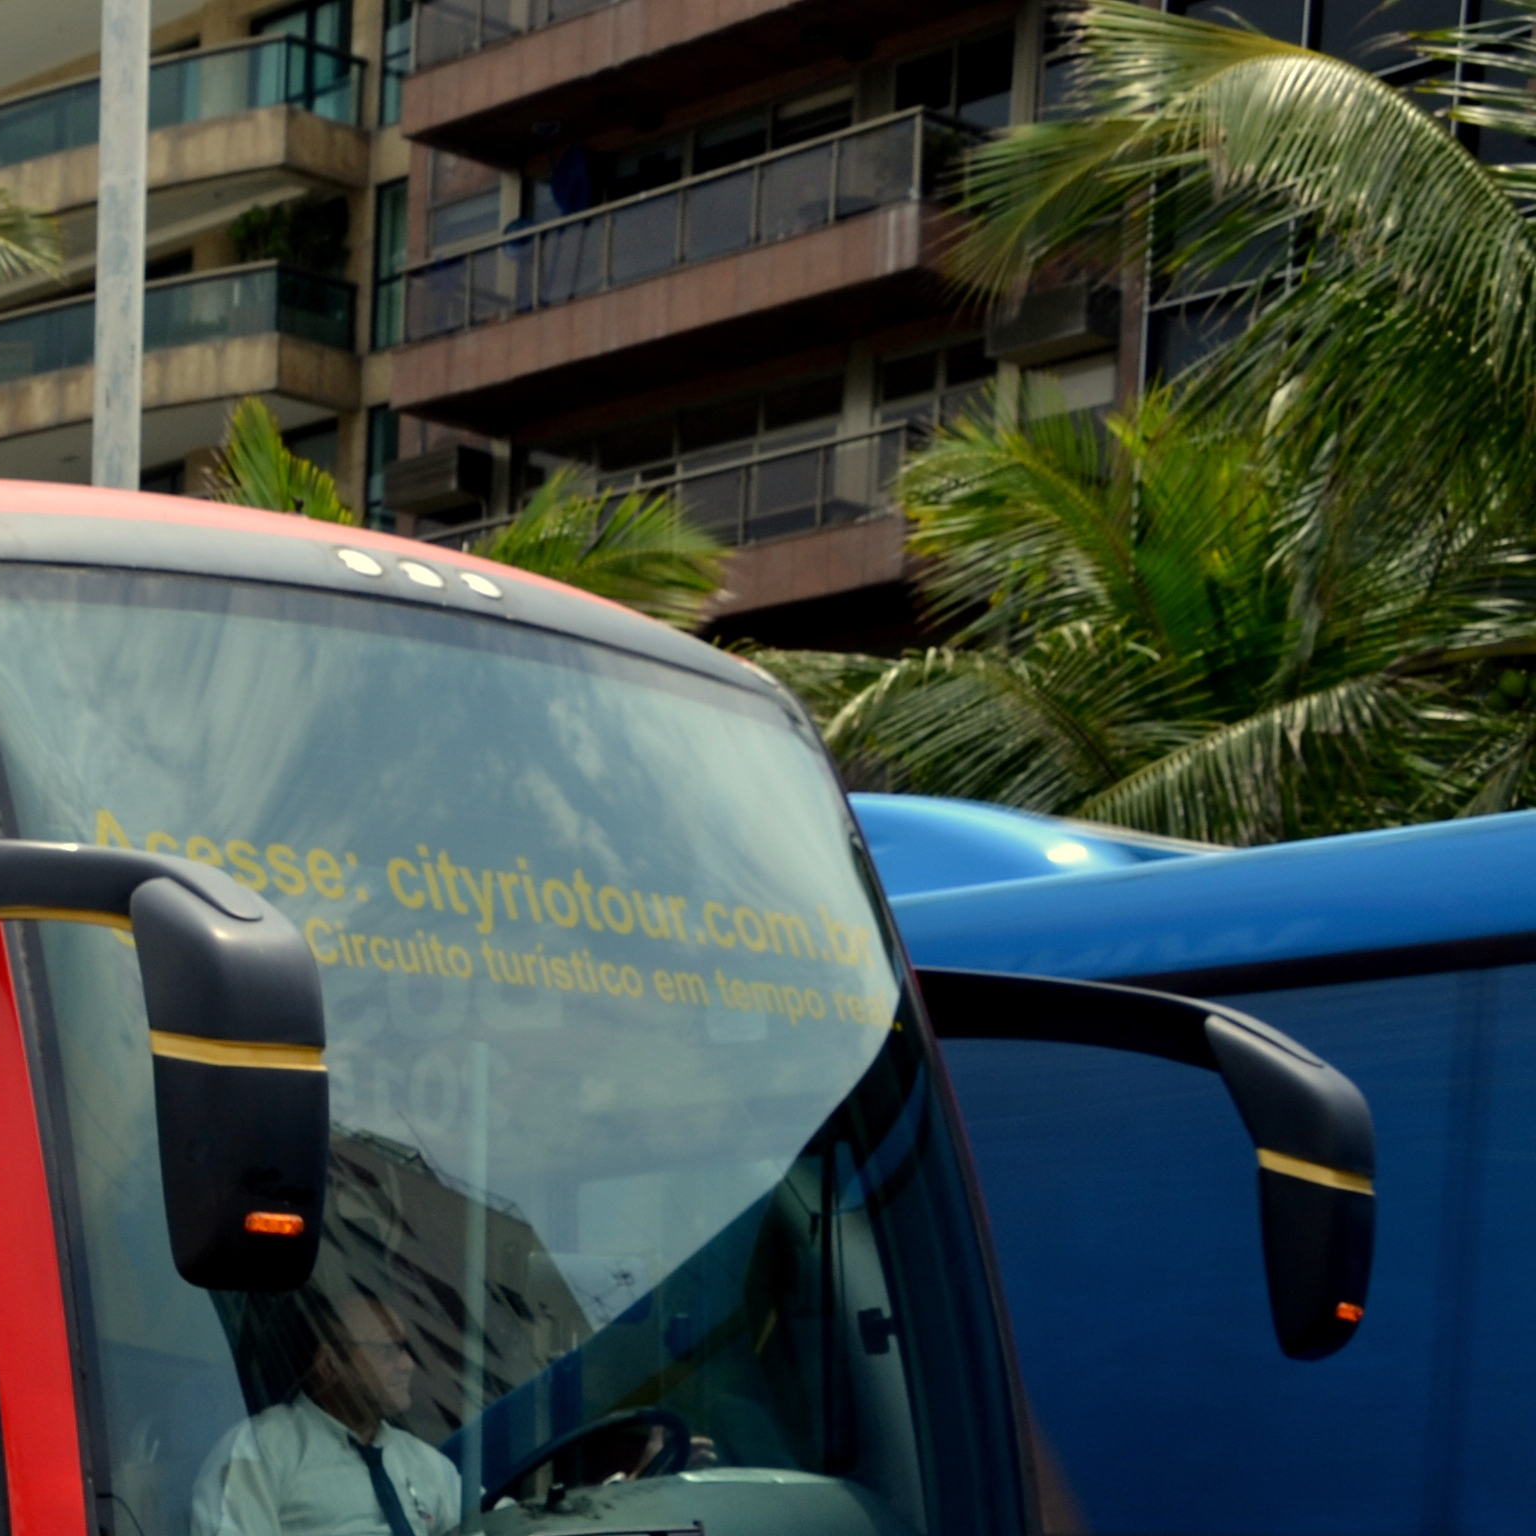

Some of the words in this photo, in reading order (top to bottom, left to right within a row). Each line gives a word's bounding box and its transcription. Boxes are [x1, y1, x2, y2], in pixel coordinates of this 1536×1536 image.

[387, 843, 876, 970] cityriotour.com.br
[305, 917, 473, 979] Circuito
[653, 968, 711, 1006] em
[715, 967, 826, 1027] tempo
